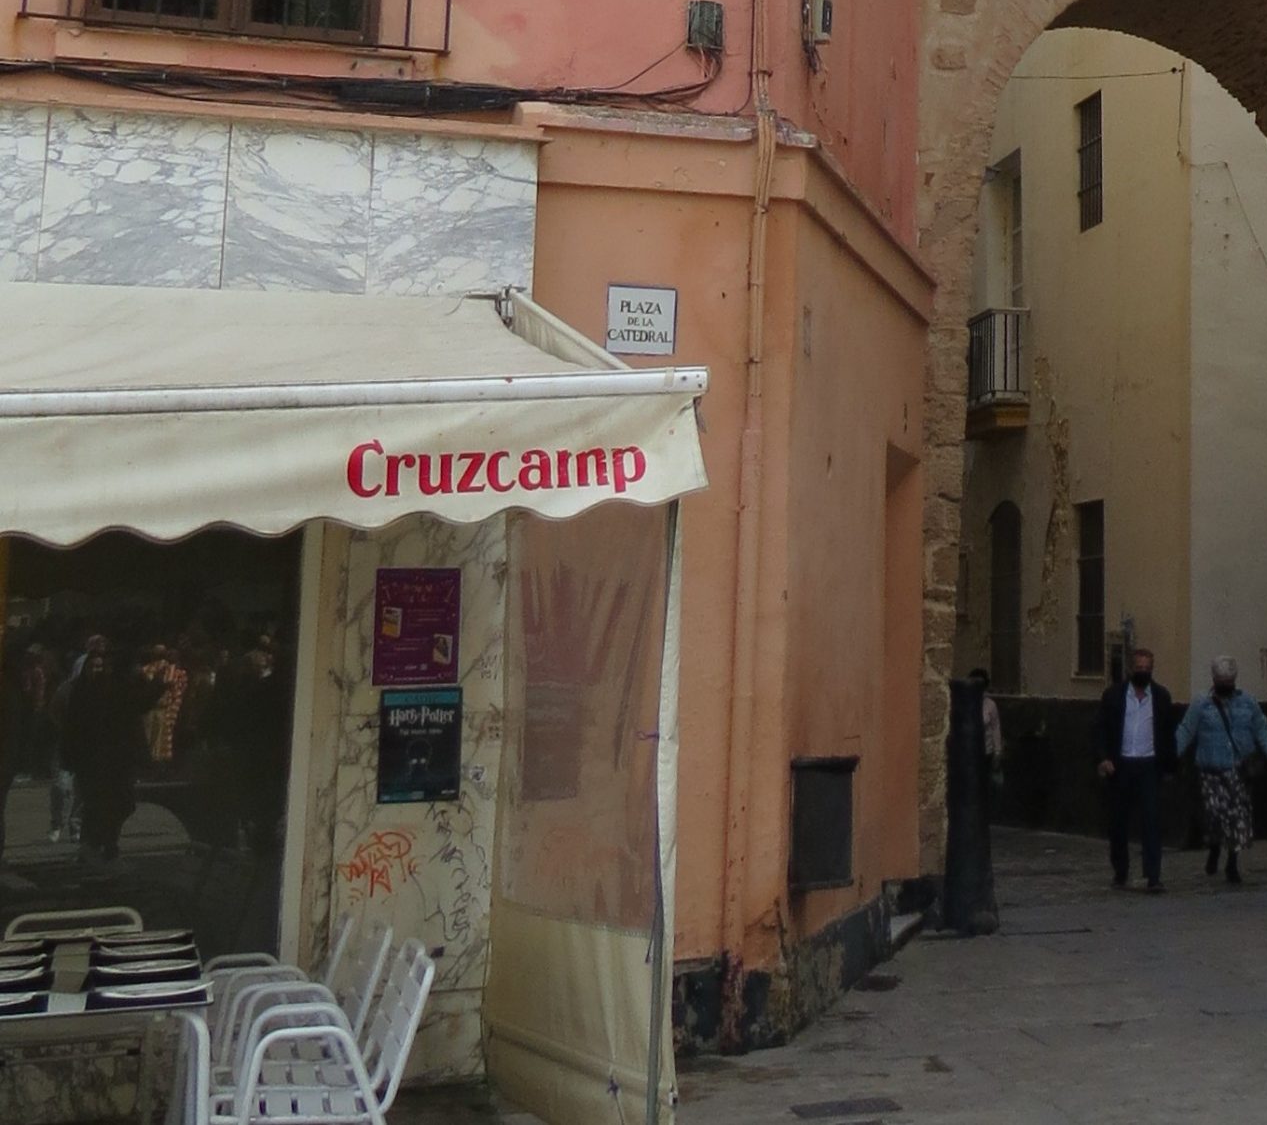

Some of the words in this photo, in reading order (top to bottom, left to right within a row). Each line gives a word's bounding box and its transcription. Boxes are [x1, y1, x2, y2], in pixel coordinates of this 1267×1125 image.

[620, 300, 662, 315] PLAZA
[627, 316, 640, 327] DE
[642, 317, 654, 327] LA
[607, 328, 673, 344] CATEDRAL
[347, 439, 647, 498] Cruzcamp
[389, 708, 418, 727] Harry
